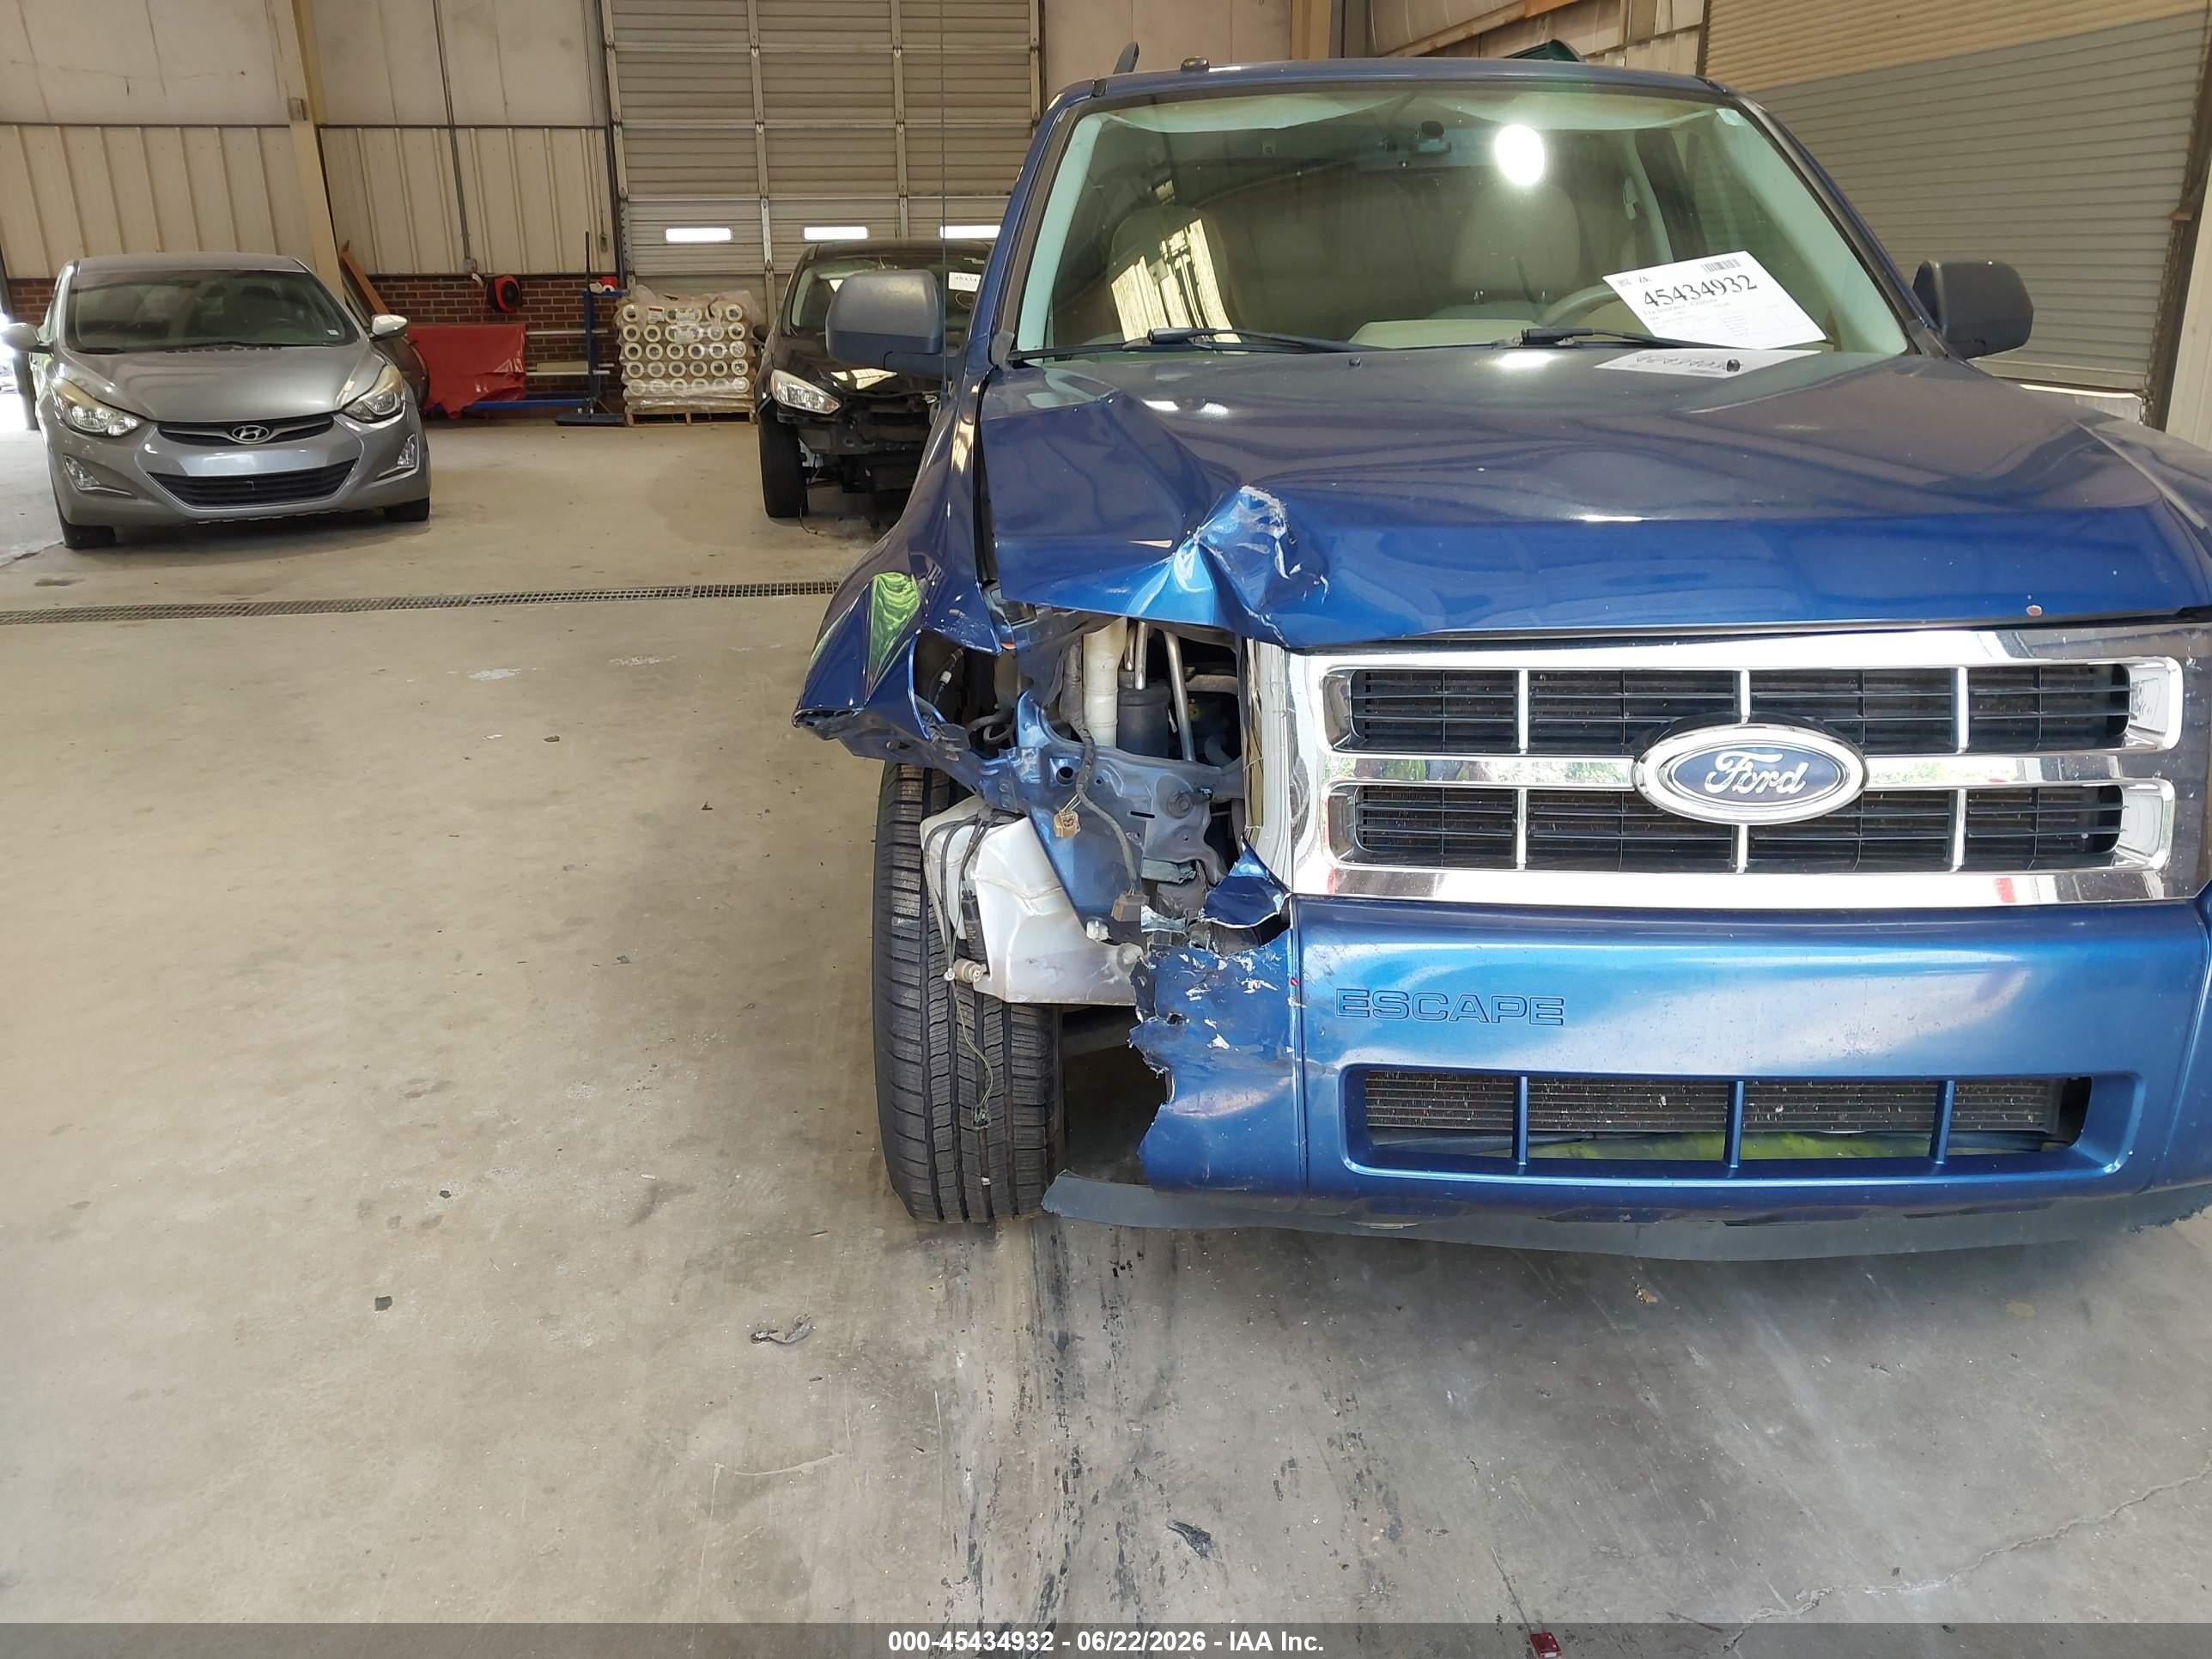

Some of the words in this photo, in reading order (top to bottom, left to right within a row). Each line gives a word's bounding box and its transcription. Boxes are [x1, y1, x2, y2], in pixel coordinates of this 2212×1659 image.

[1644, 274, 1758, 307] 45434932
[1704, 750, 1810, 794] Ford
[1335, 988, 1564, 1025] ESCAPE
